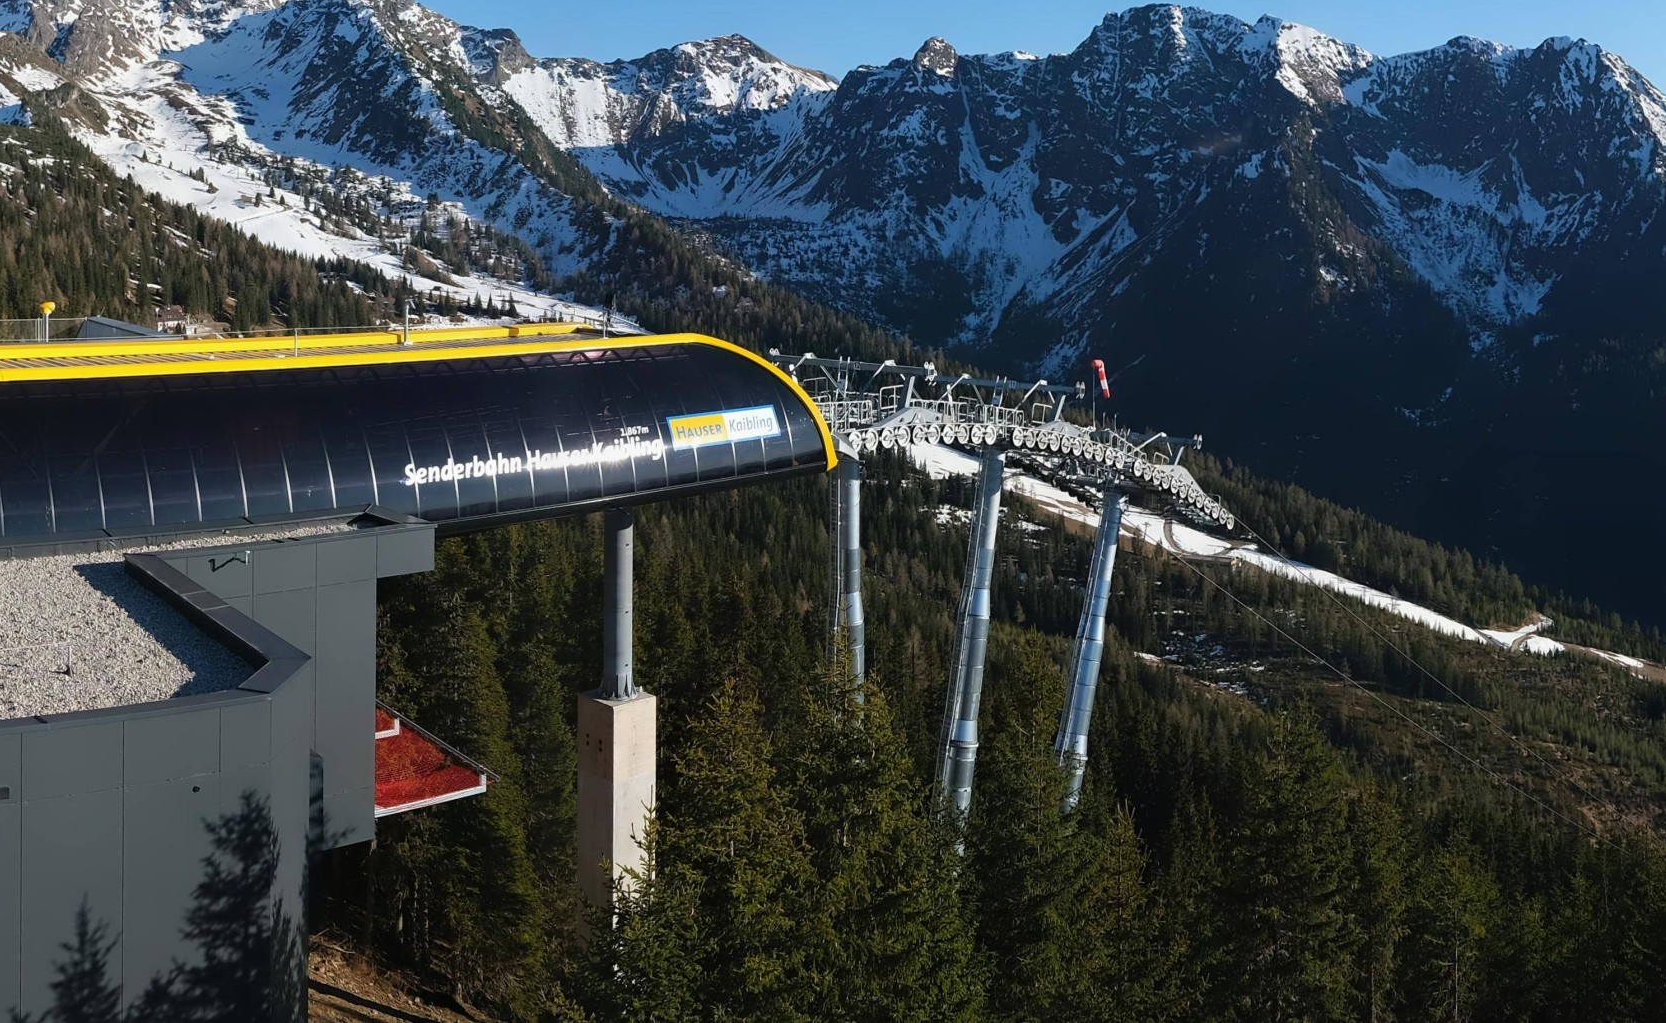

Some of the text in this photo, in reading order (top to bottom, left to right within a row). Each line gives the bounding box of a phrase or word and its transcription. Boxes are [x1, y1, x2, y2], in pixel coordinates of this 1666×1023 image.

[619, 425, 650, 437] 1.867m
[675, 415, 773, 440] HAUSER Kaibling
[404, 435, 664, 486] Senderbahn Hauser Kaibling
